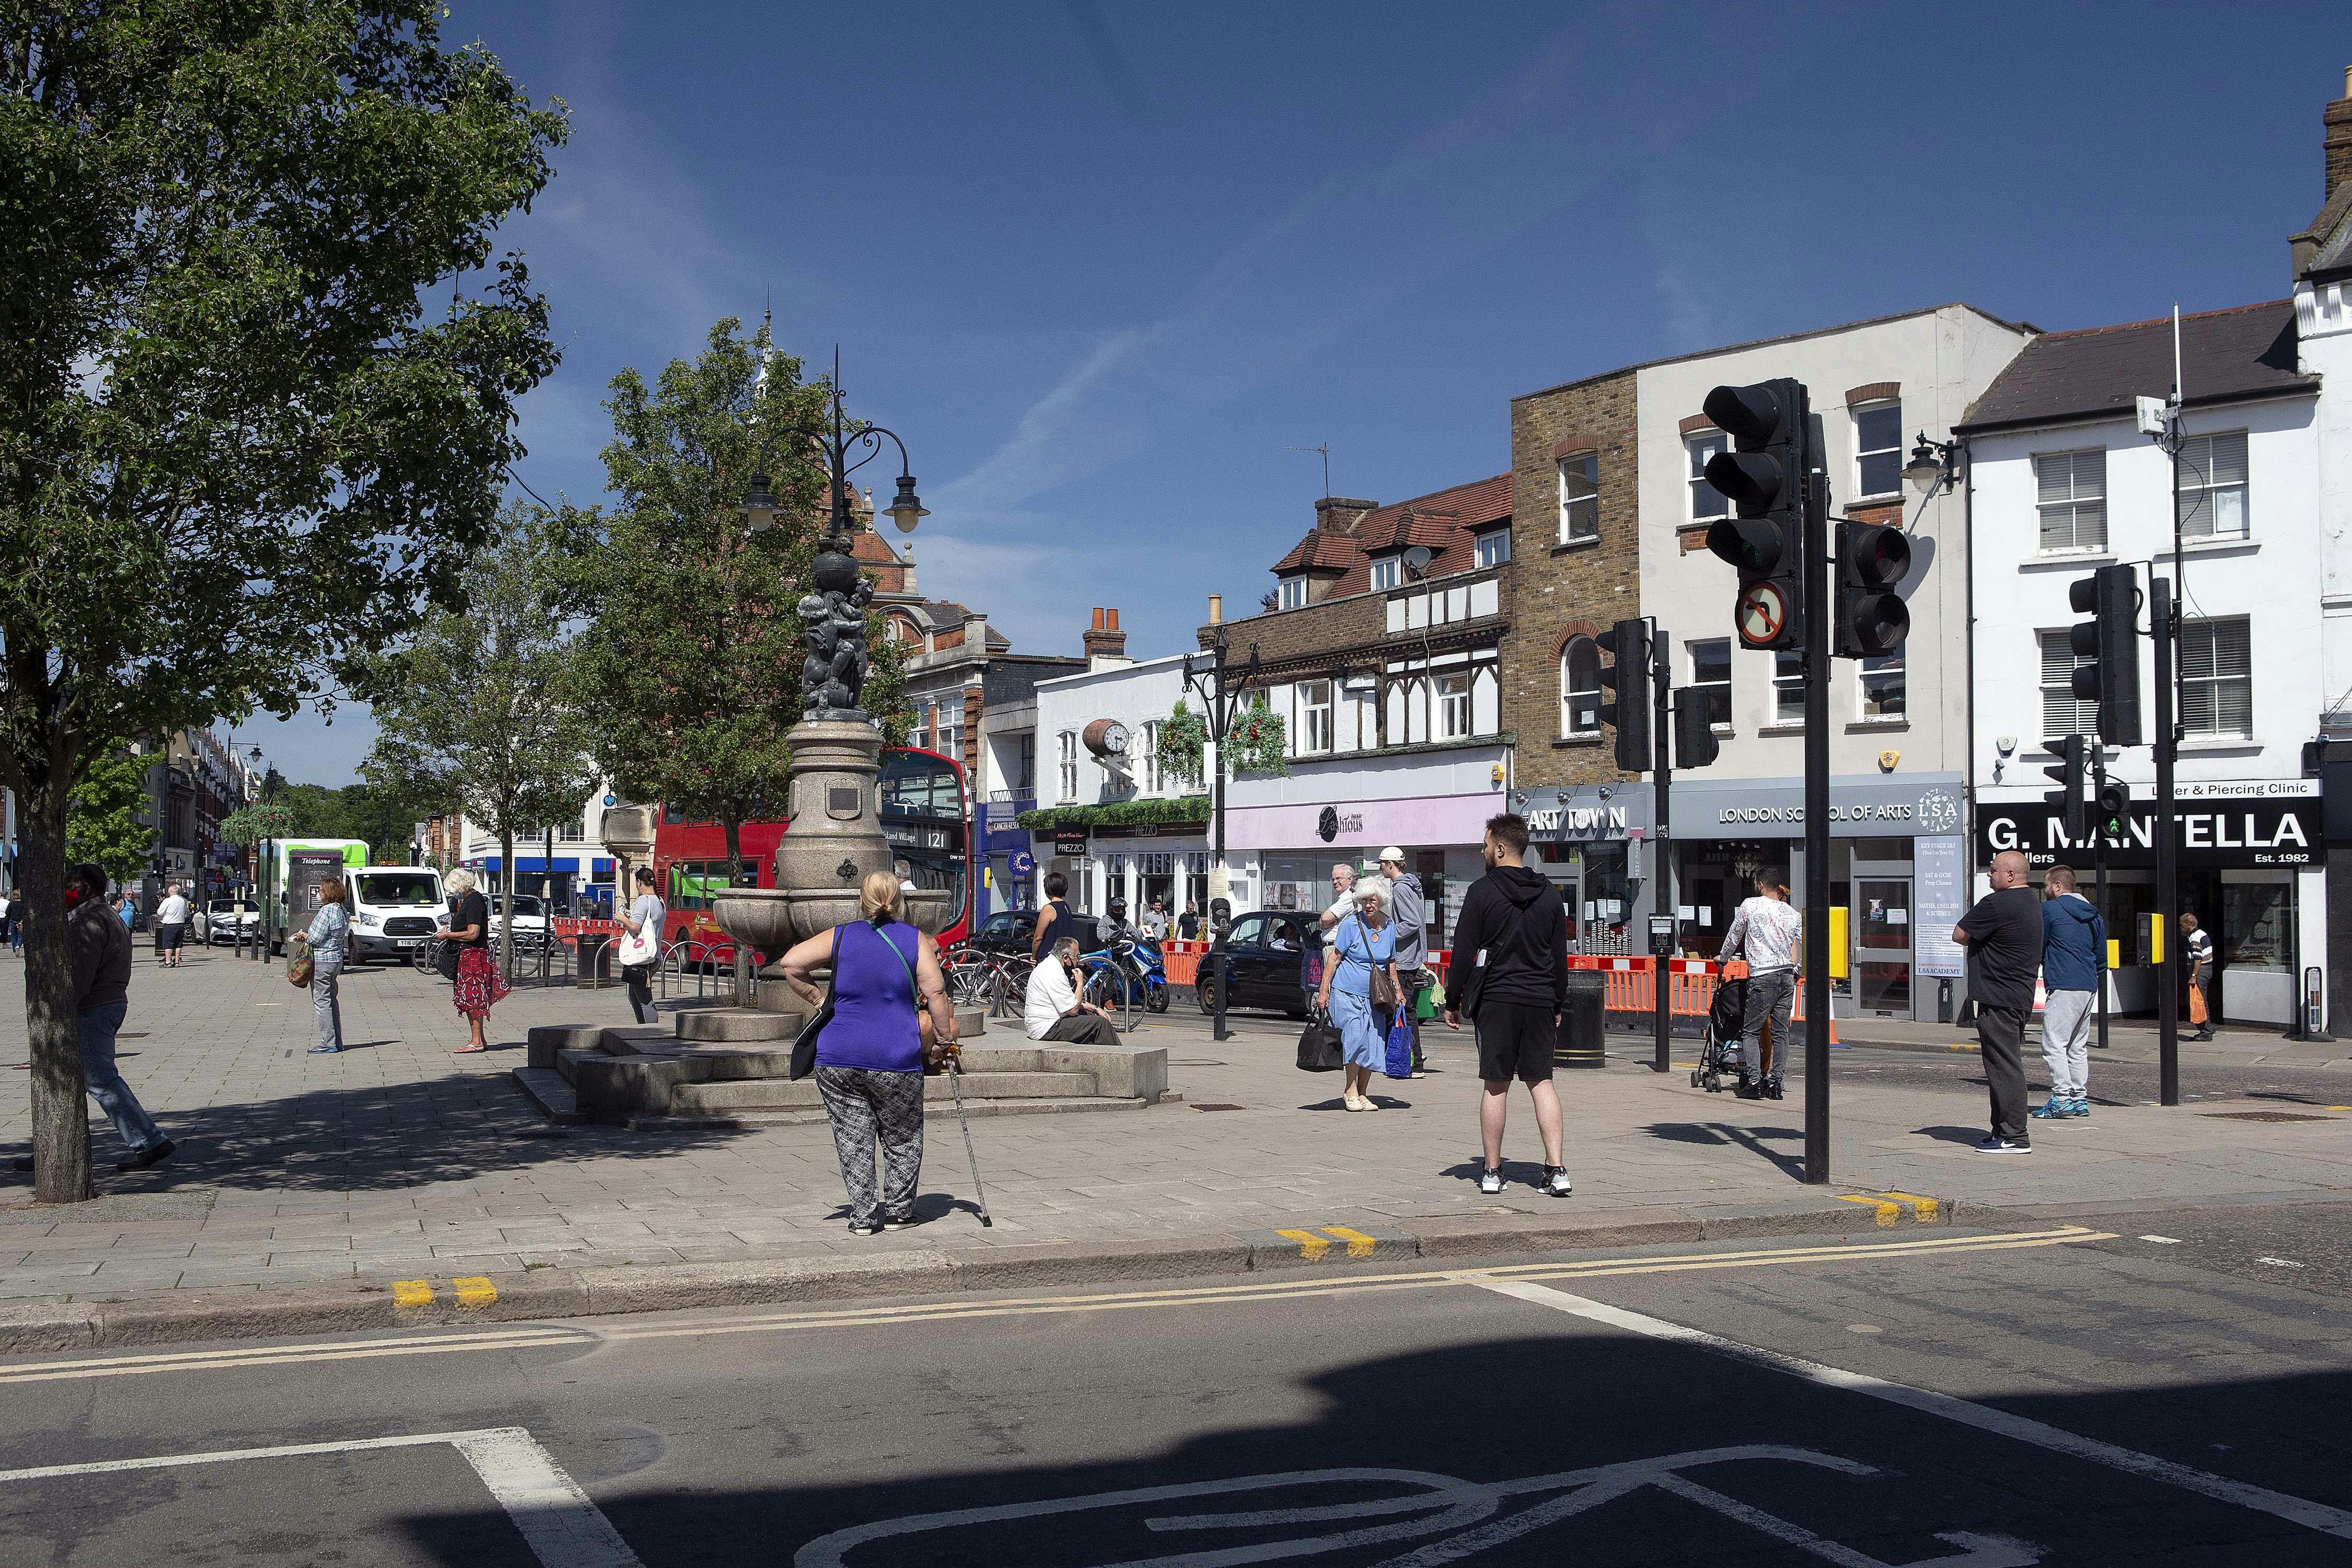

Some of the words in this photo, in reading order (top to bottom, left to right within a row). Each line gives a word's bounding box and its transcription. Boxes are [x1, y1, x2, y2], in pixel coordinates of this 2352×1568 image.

[2152, 785, 2188, 796] Ler
[2193, 785, 2204, 795] &
[2208, 785, 2265, 796] Piercing
[2269, 783, 2308, 793] Clinic
[1719, 807, 1782, 823] LONDON
[1786, 806, 1848, 822] SCOL
[1851, 805, 1872, 821] OF
[1875, 804, 1912, 820] ARTS
[1918, 803, 1957, 817] LSA
[1009, 821, 1020, 829] RESEA
[1528, 810, 1562, 831] ART
[1567, 807, 1625, 829] TOWN
[1135, 824, 1157, 836] PREZZO
[1988, 817, 2030, 850] G.
[2047, 813, 2309, 849] MNELLA
[898, 832, 916, 843] Village
[928, 833, 944, 848] 121
[1058, 844, 1085, 852] PREZZO
[2255, 854, 2275, 862] Est.
[2278, 854, 2309, 863] 1982
